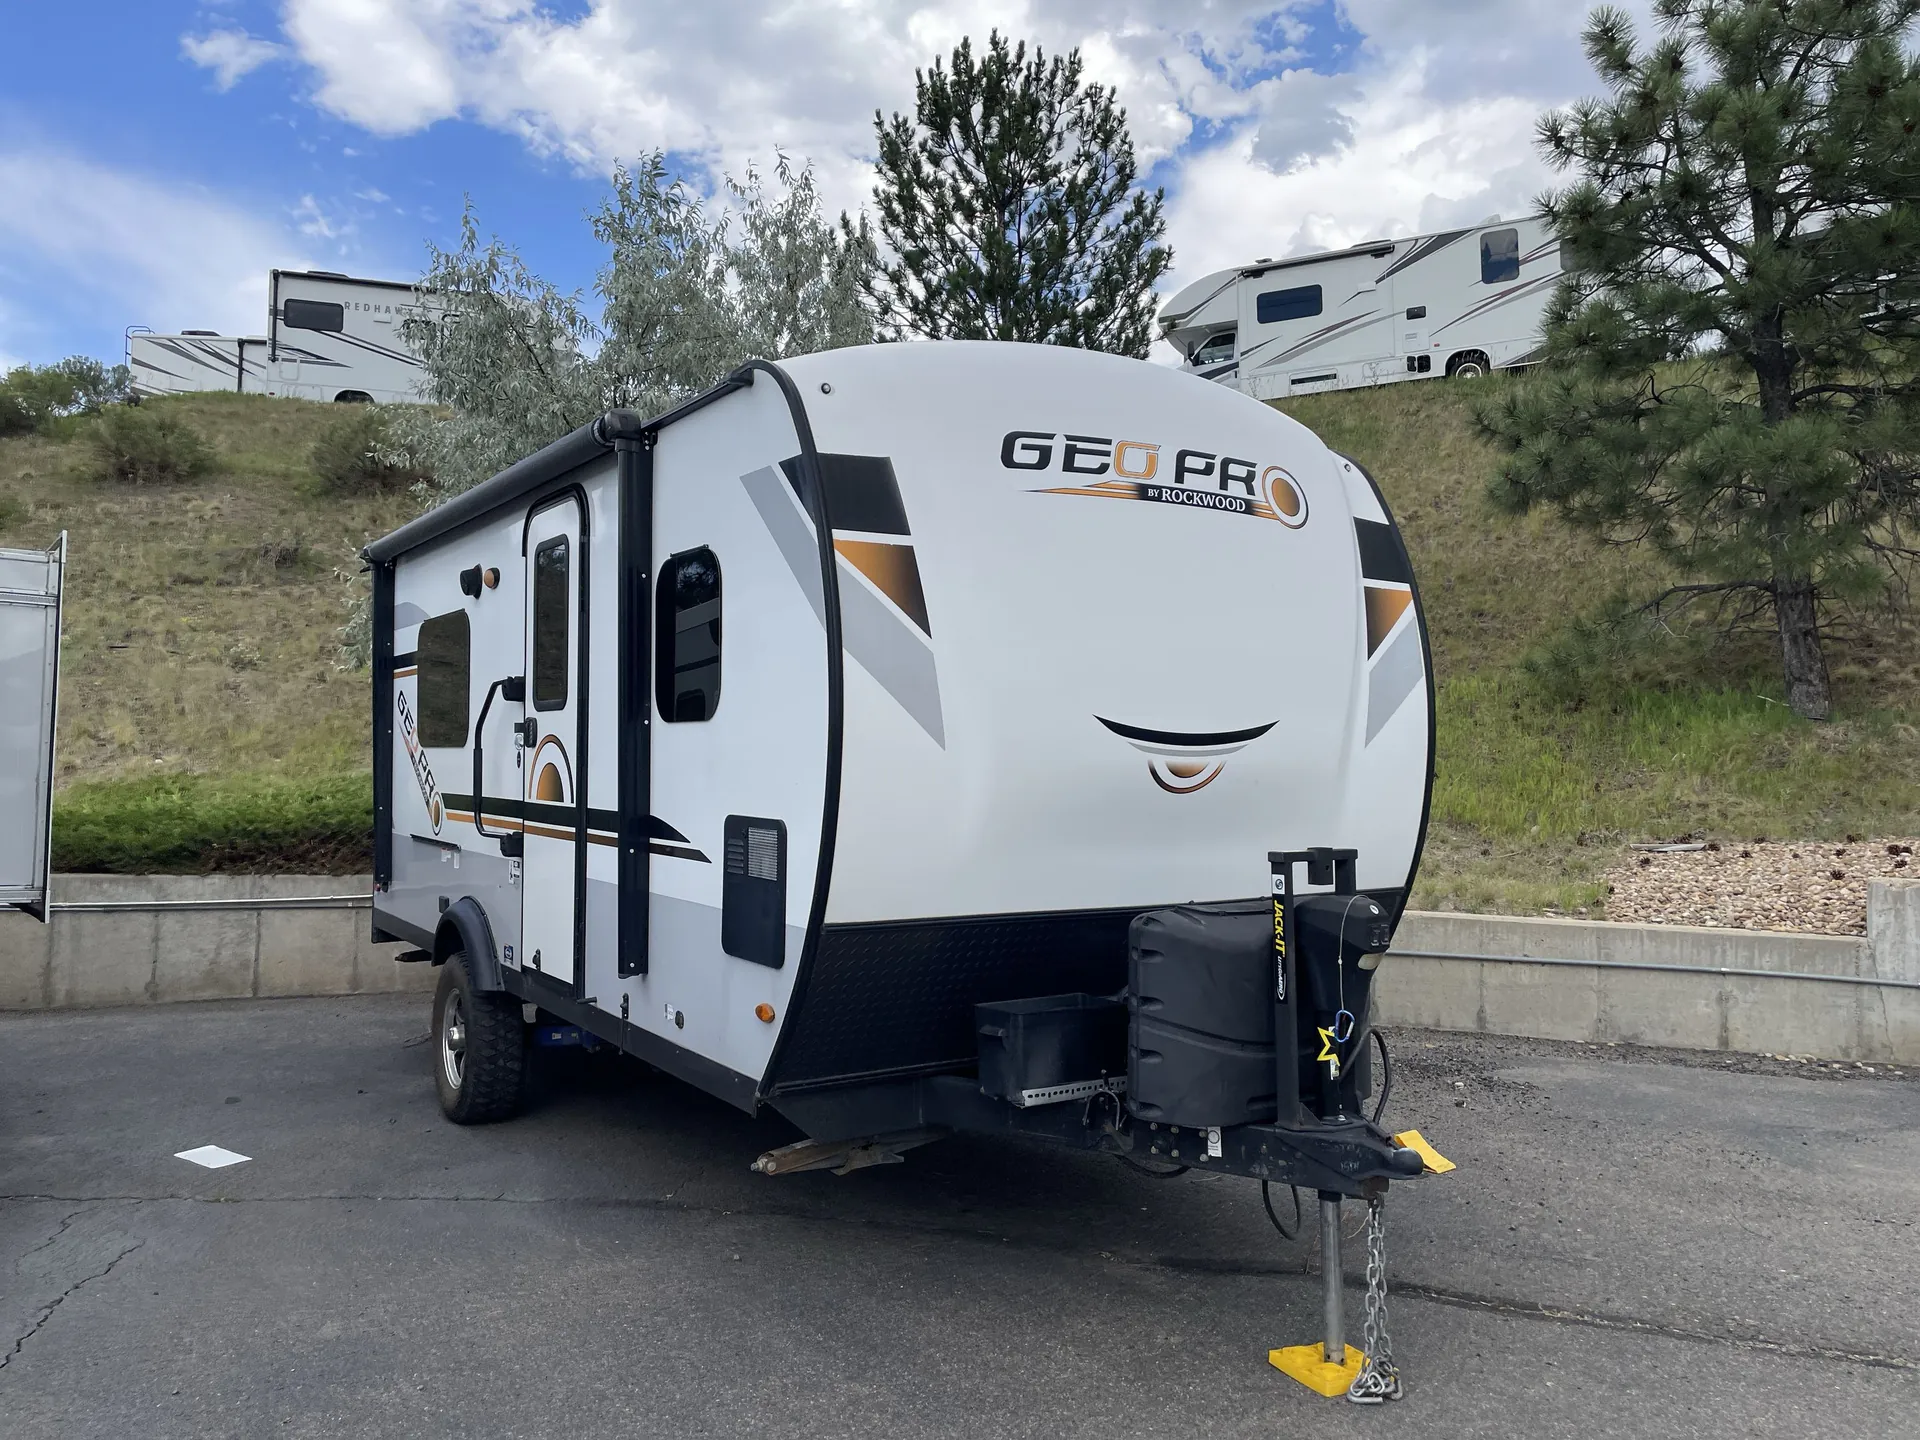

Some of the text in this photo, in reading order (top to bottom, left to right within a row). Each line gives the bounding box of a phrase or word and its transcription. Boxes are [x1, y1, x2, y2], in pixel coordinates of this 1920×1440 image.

[1000, 431, 1309, 530] GEO PRO
[1147, 488, 1246, 512] BY ROCKWOOD
[397, 690, 418, 754] GEO
[1274, 899, 1286, 955] JACK-IT
